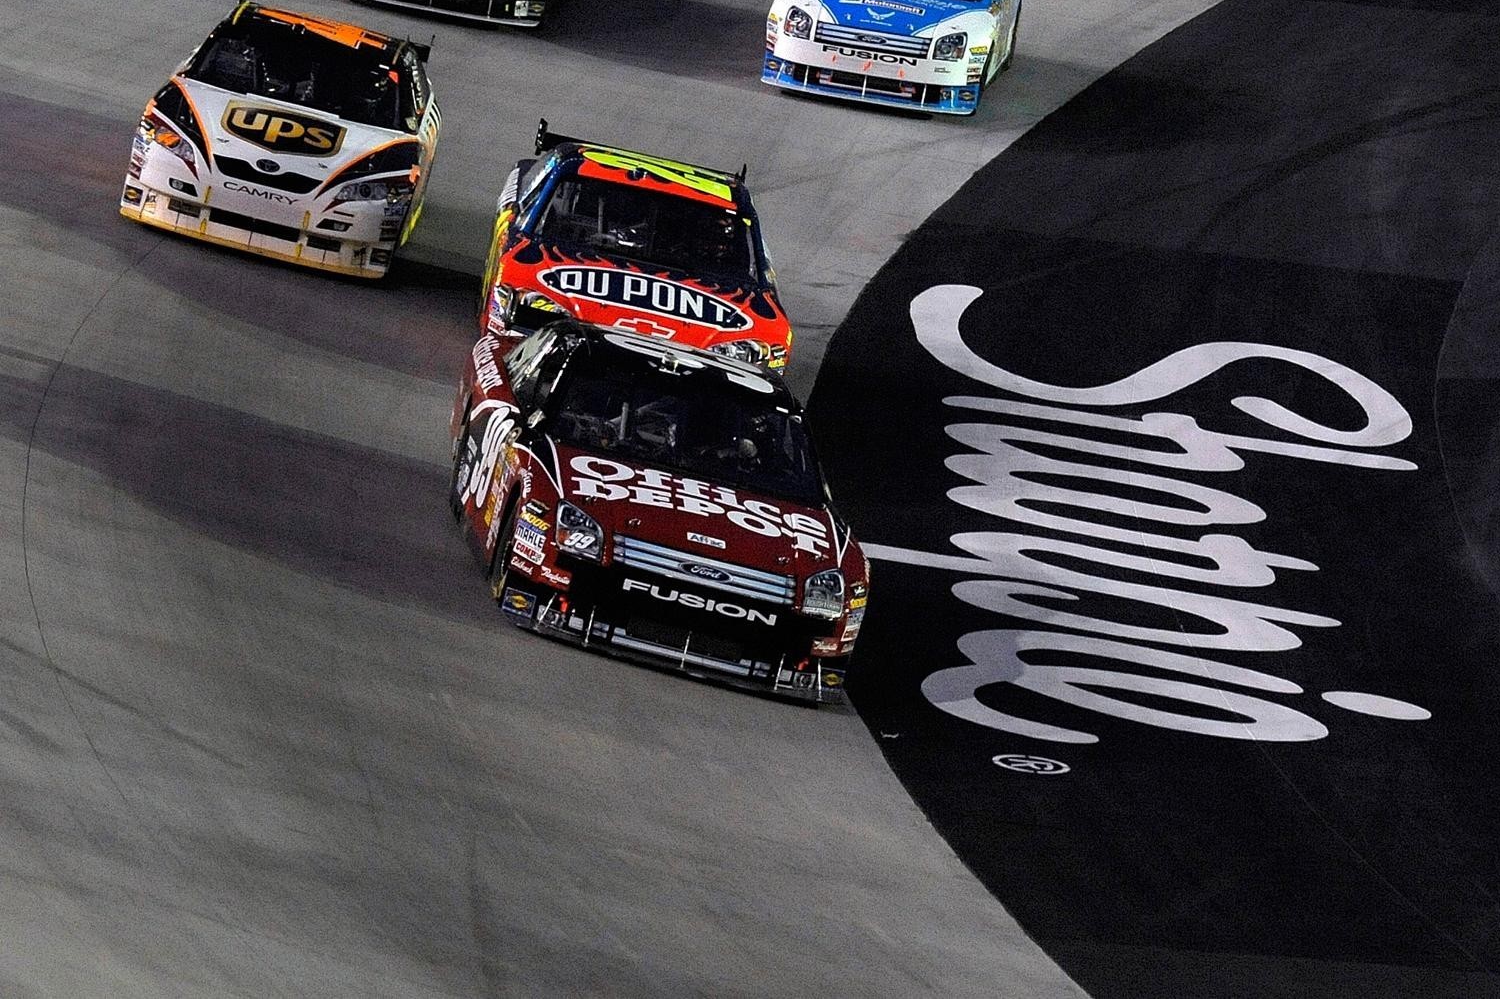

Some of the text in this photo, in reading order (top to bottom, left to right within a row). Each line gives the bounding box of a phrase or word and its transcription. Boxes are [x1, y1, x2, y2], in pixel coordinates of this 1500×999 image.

[822, 45, 918, 66] FUSION
[230, 107, 335, 152] ups
[223, 180, 300, 206] CAMRY
[559, 269, 733, 323] DU PONT
[570, 455, 828, 536] Office
[522, 511, 552, 532] MOOG
[572, 477, 830, 561] DEPOT
[862, 284, 1432, 744] Sharpie
[515, 524, 545, 549] MAHLE
[564, 531, 596, 551] 99
[516, 542, 537, 560] COMP
[690, 565, 721, 579] Ford
[622, 579, 778, 626] FUSION
